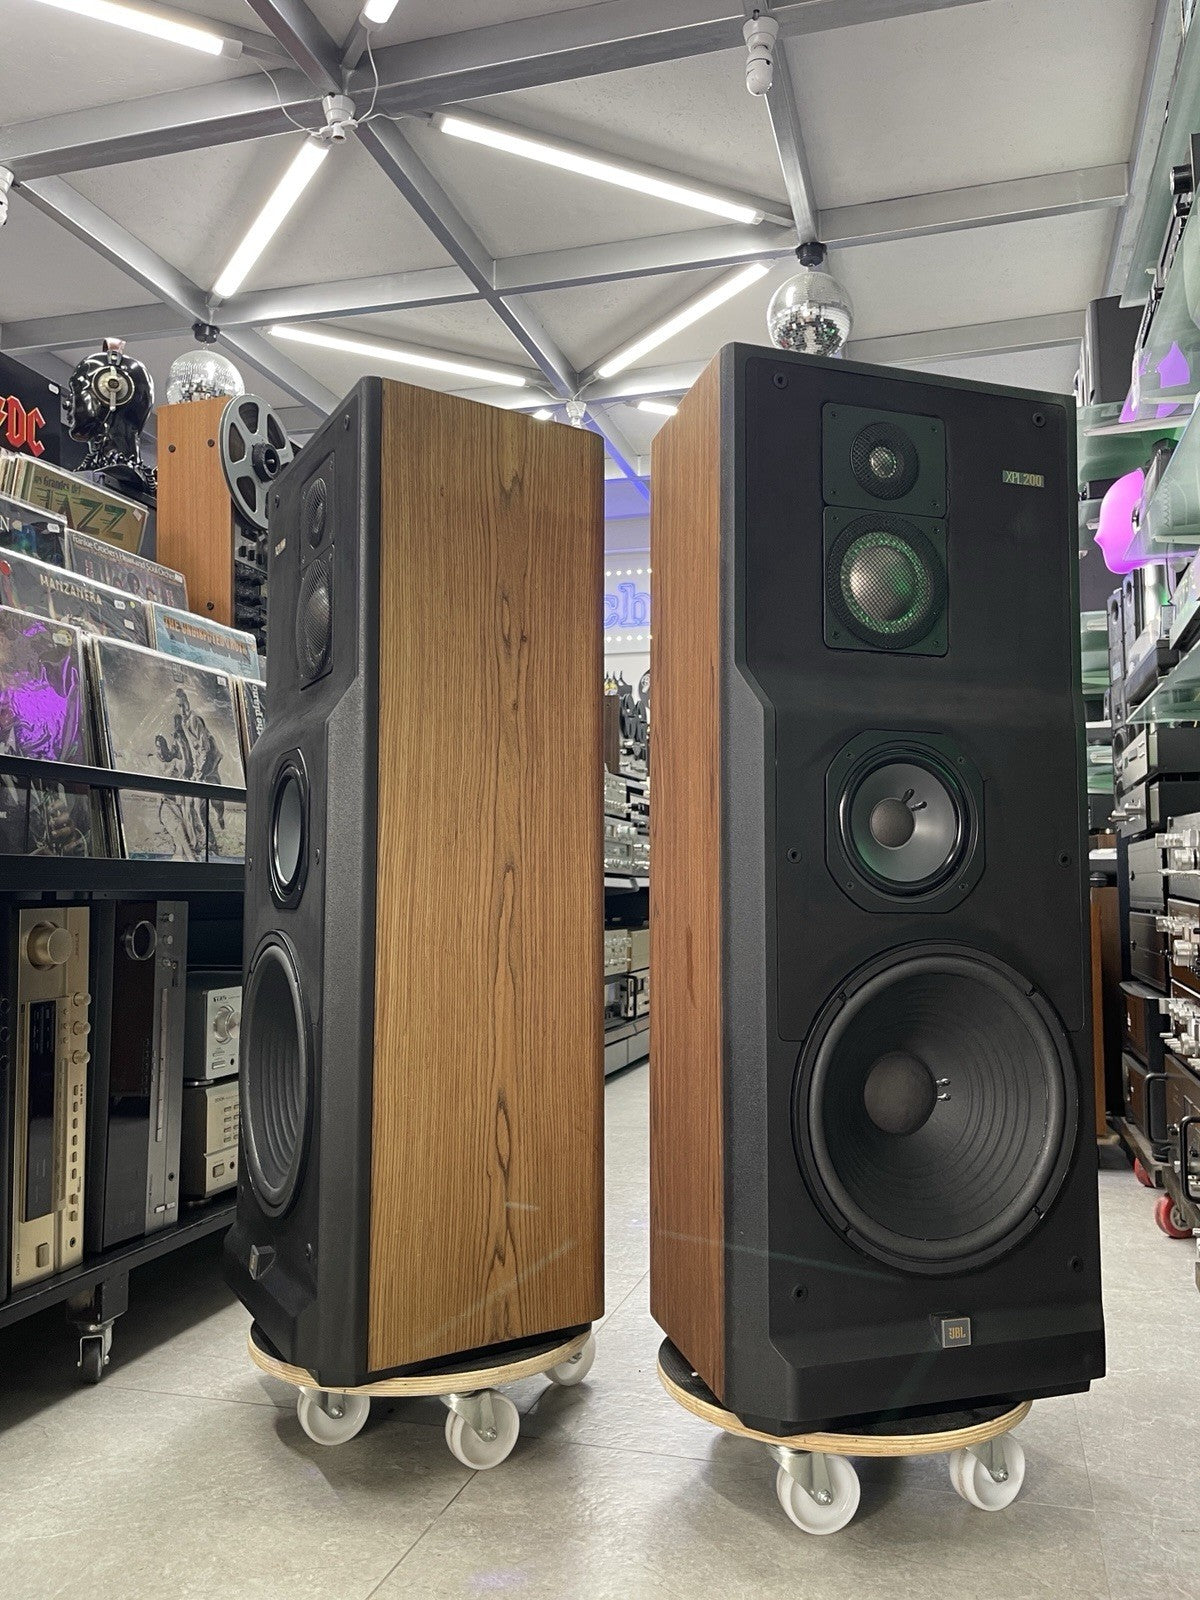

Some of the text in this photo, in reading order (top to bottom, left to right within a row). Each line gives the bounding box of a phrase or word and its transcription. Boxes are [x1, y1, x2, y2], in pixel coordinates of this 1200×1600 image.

[1005, 470, 1042, 487] XPL 200
[36, 487, 126, 541] JAZZ
[40, 573, 103, 606] MANZANERA
[948, 1326, 966, 1340] JBL
